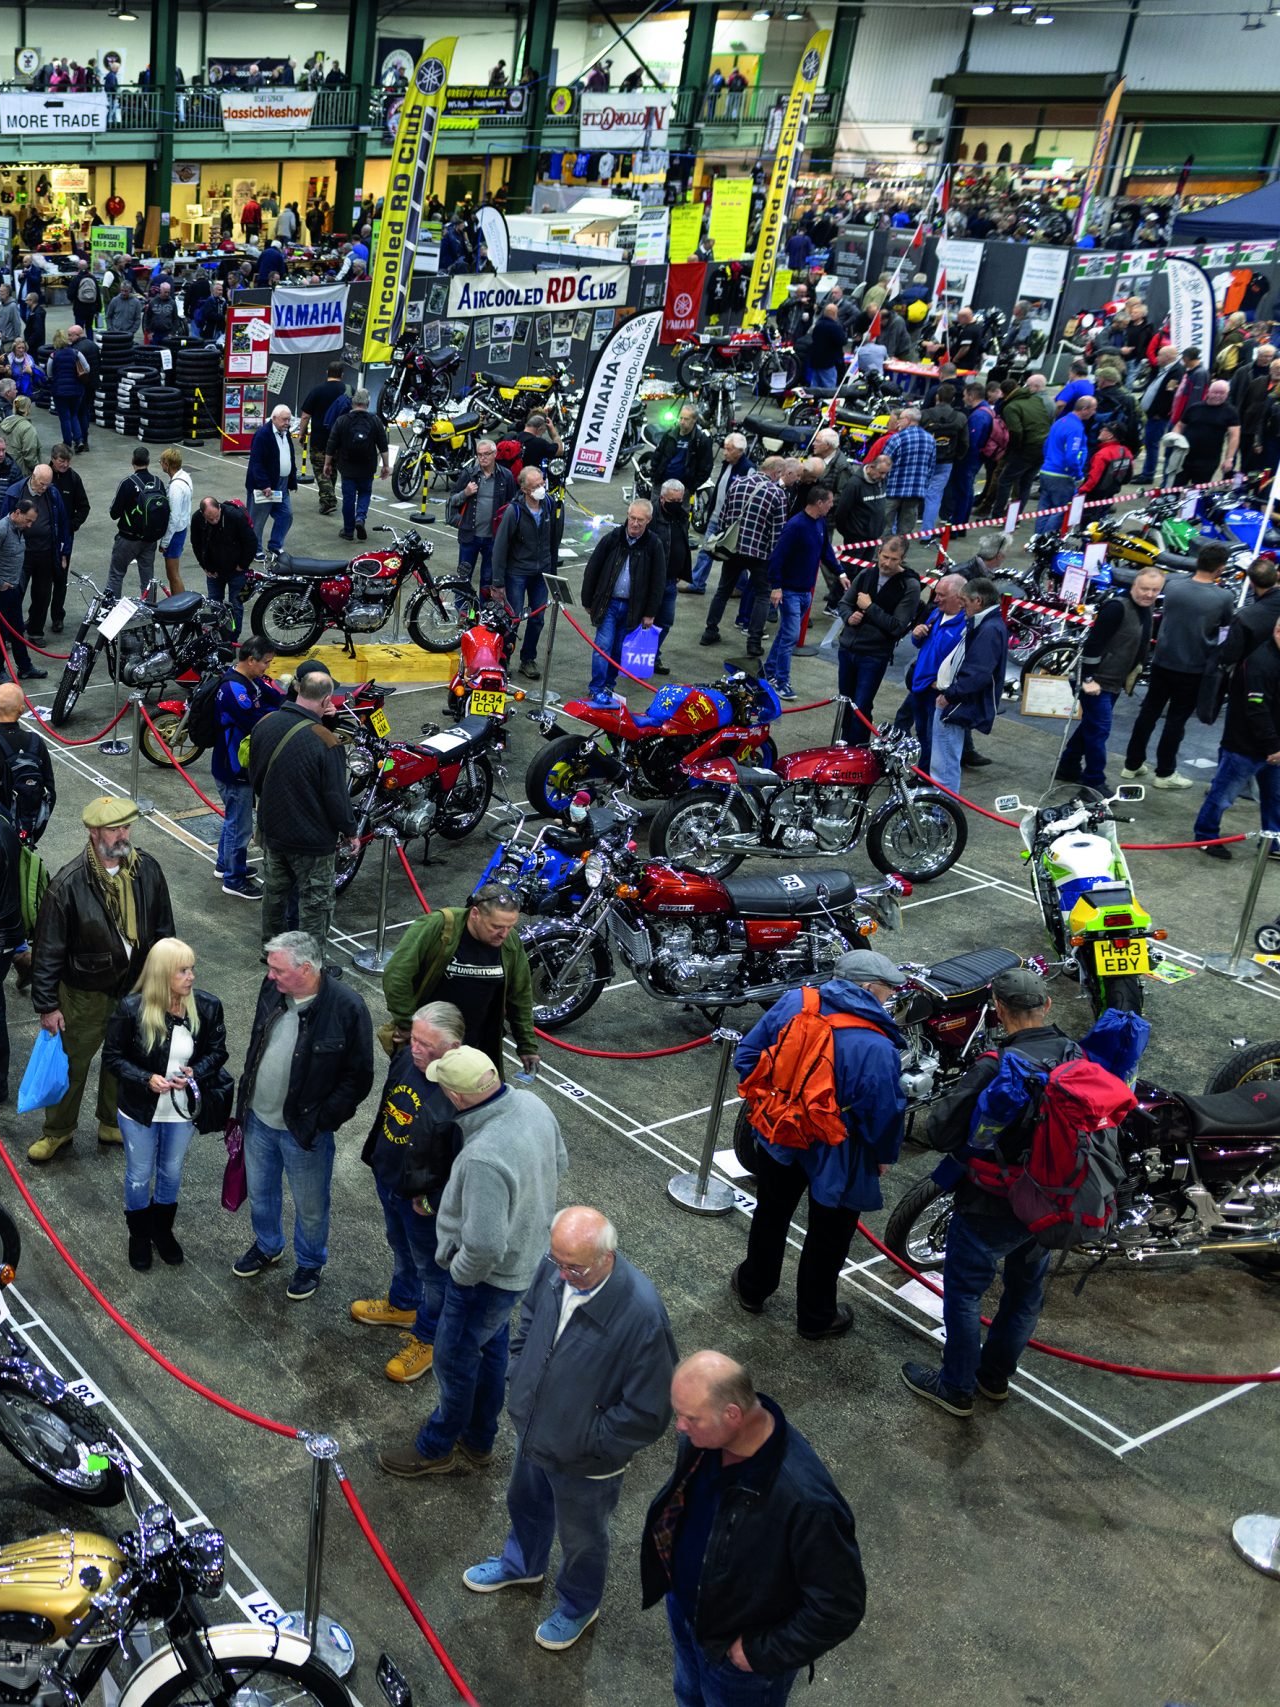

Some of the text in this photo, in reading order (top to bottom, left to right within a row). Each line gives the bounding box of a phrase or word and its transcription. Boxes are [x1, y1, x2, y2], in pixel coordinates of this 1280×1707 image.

[6, 114, 100, 128] MORE TRADE
[370, 103, 422, 344] Aircooled RD Club
[751, 198, 782, 310] Aircooled
[775, 157, 789, 189] RD
[457, 274, 617, 311] AIRCOOLED RD CLUB
[274, 301, 343, 327] YAMAHA
[665, 318, 695, 330] YAMAHA
[605, 316, 657, 463] www.AircooledRDclub.com
[585, 359, 622, 445] YAMAHA
[579, 449, 600, 461] bmf
[575, 464, 599, 474] MAG
[626, 652, 656, 667] TATE
[473, 692, 503, 705] B434
[475, 702, 498, 713] CCV
[831, 769, 863, 780] Triton
[1104, 958, 1140, 972] EBY
[559, 1083, 585, 1098] 29
[734, 1195, 755, 1208] 31
[247, 1601, 278, 1623] 37
